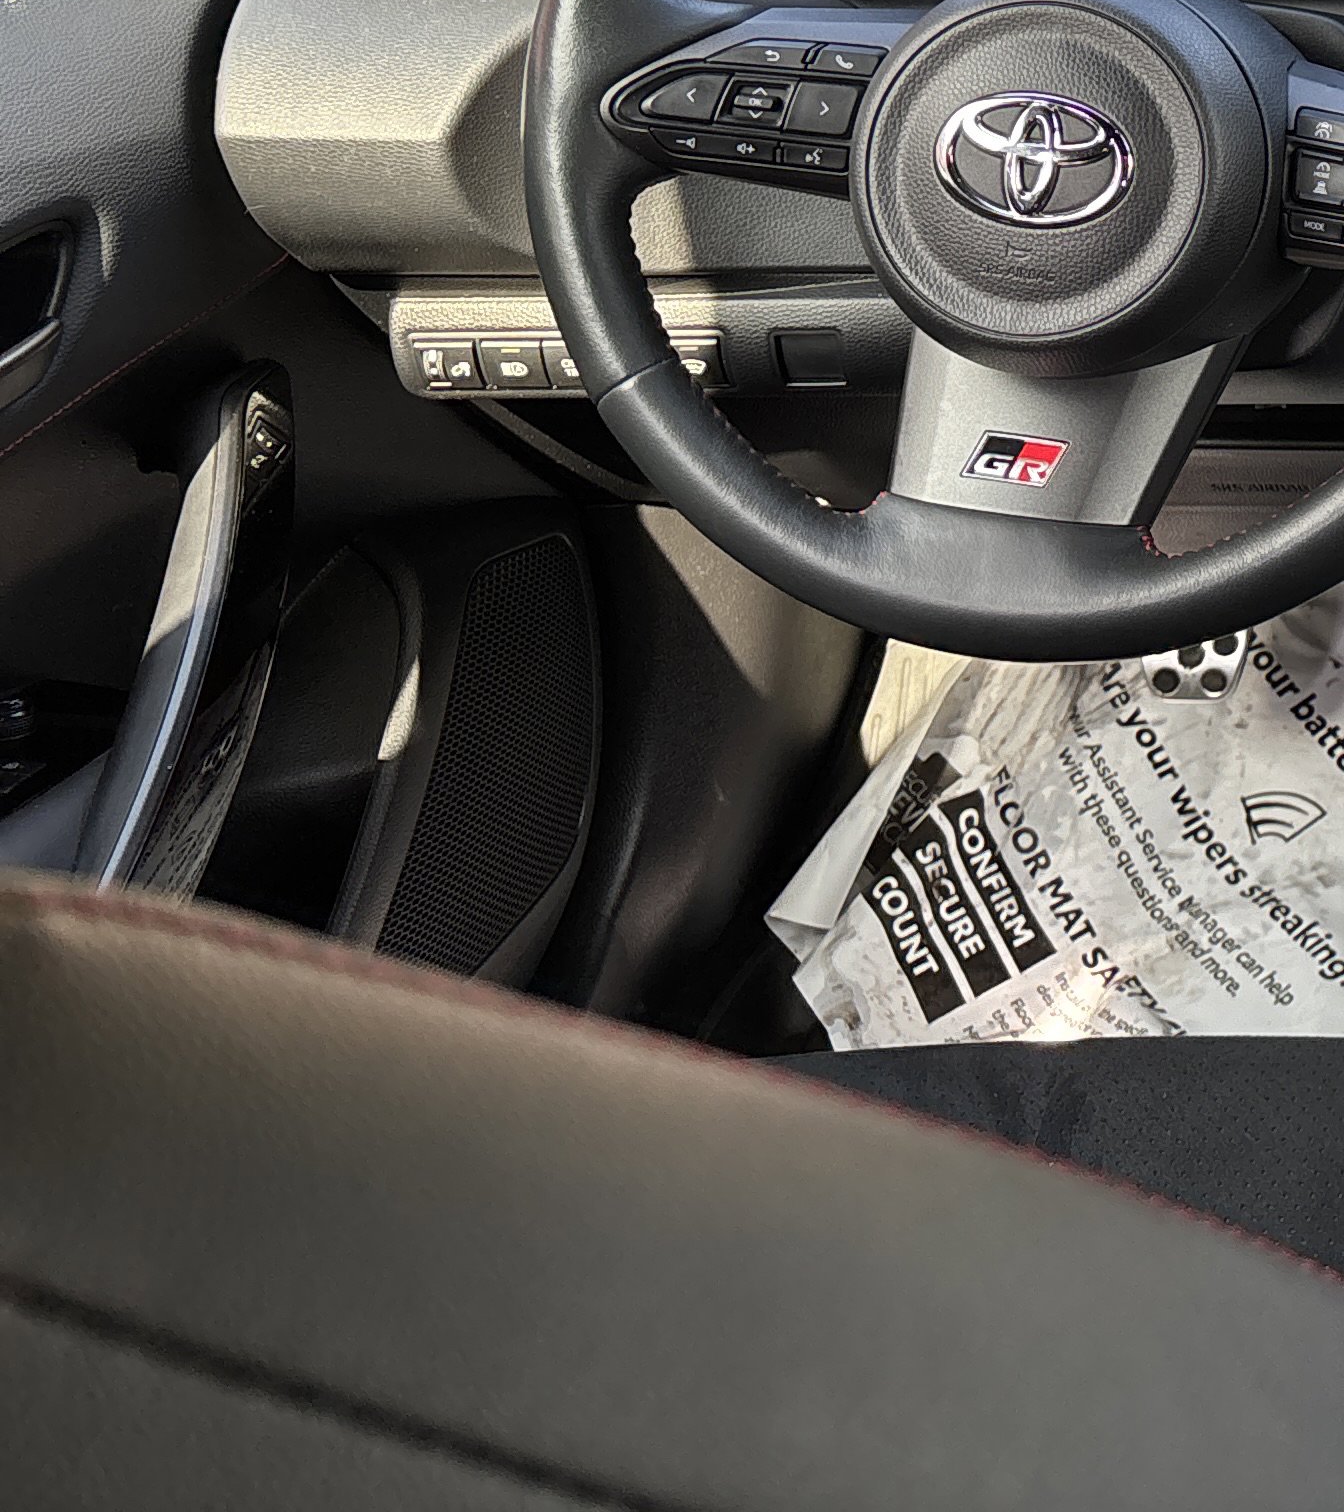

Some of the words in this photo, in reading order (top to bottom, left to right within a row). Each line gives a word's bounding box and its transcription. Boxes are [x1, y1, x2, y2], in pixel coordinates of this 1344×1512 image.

[1303, 219, 1326, 232] MODE
[972, 452, 1051, 483] GR
[993, 763, 1051, 879] FLOOR
[1038, 875, 1098, 944] MAT
[1058, 746, 1090, 796] with
[1078, 792, 1122, 849] these
[1117, 849, 1181, 932] questions
[1174, 931, 1213, 960] and
[1115, 706, 1180, 781] your
[1170, 784, 1248, 886] wipers
[872, 875, 940, 977] COUNT
[915, 841, 986, 960] SECURE
[958, 807, 1036, 949] CONFIRM
[1083, 743, 1143, 830] Assistant
[1135, 828, 1183, 899] Service
[1235, 951, 1265, 979] can
[1259, 970, 1295, 1006] help
